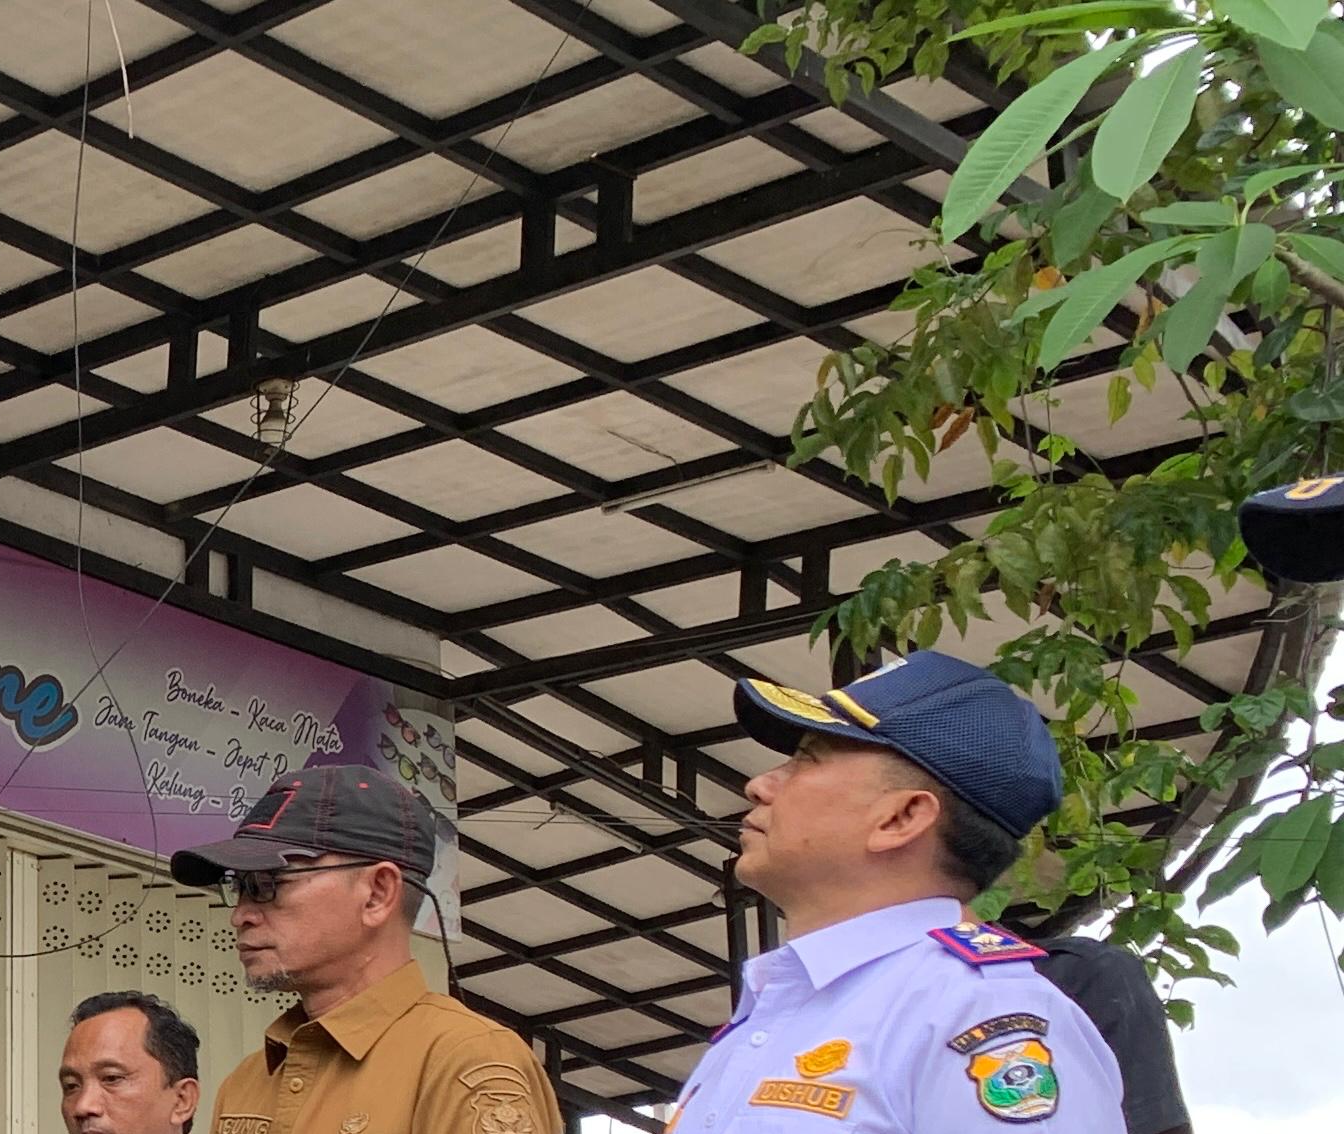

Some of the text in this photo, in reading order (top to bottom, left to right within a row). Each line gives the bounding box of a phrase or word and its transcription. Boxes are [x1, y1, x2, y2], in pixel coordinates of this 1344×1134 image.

[94, 695, 136, 731] Jam
[142, 710, 200, 756] Tangan
[224, 738, 271, 779] Jepit
[167, 670, 225, 713] Boneka
[248, 698, 288, 733] Kaca
[293, 712, 342, 752] Mata
[147, 761, 206, 812] Kalung
[760, 1082, 843, 1111] DISHUB
